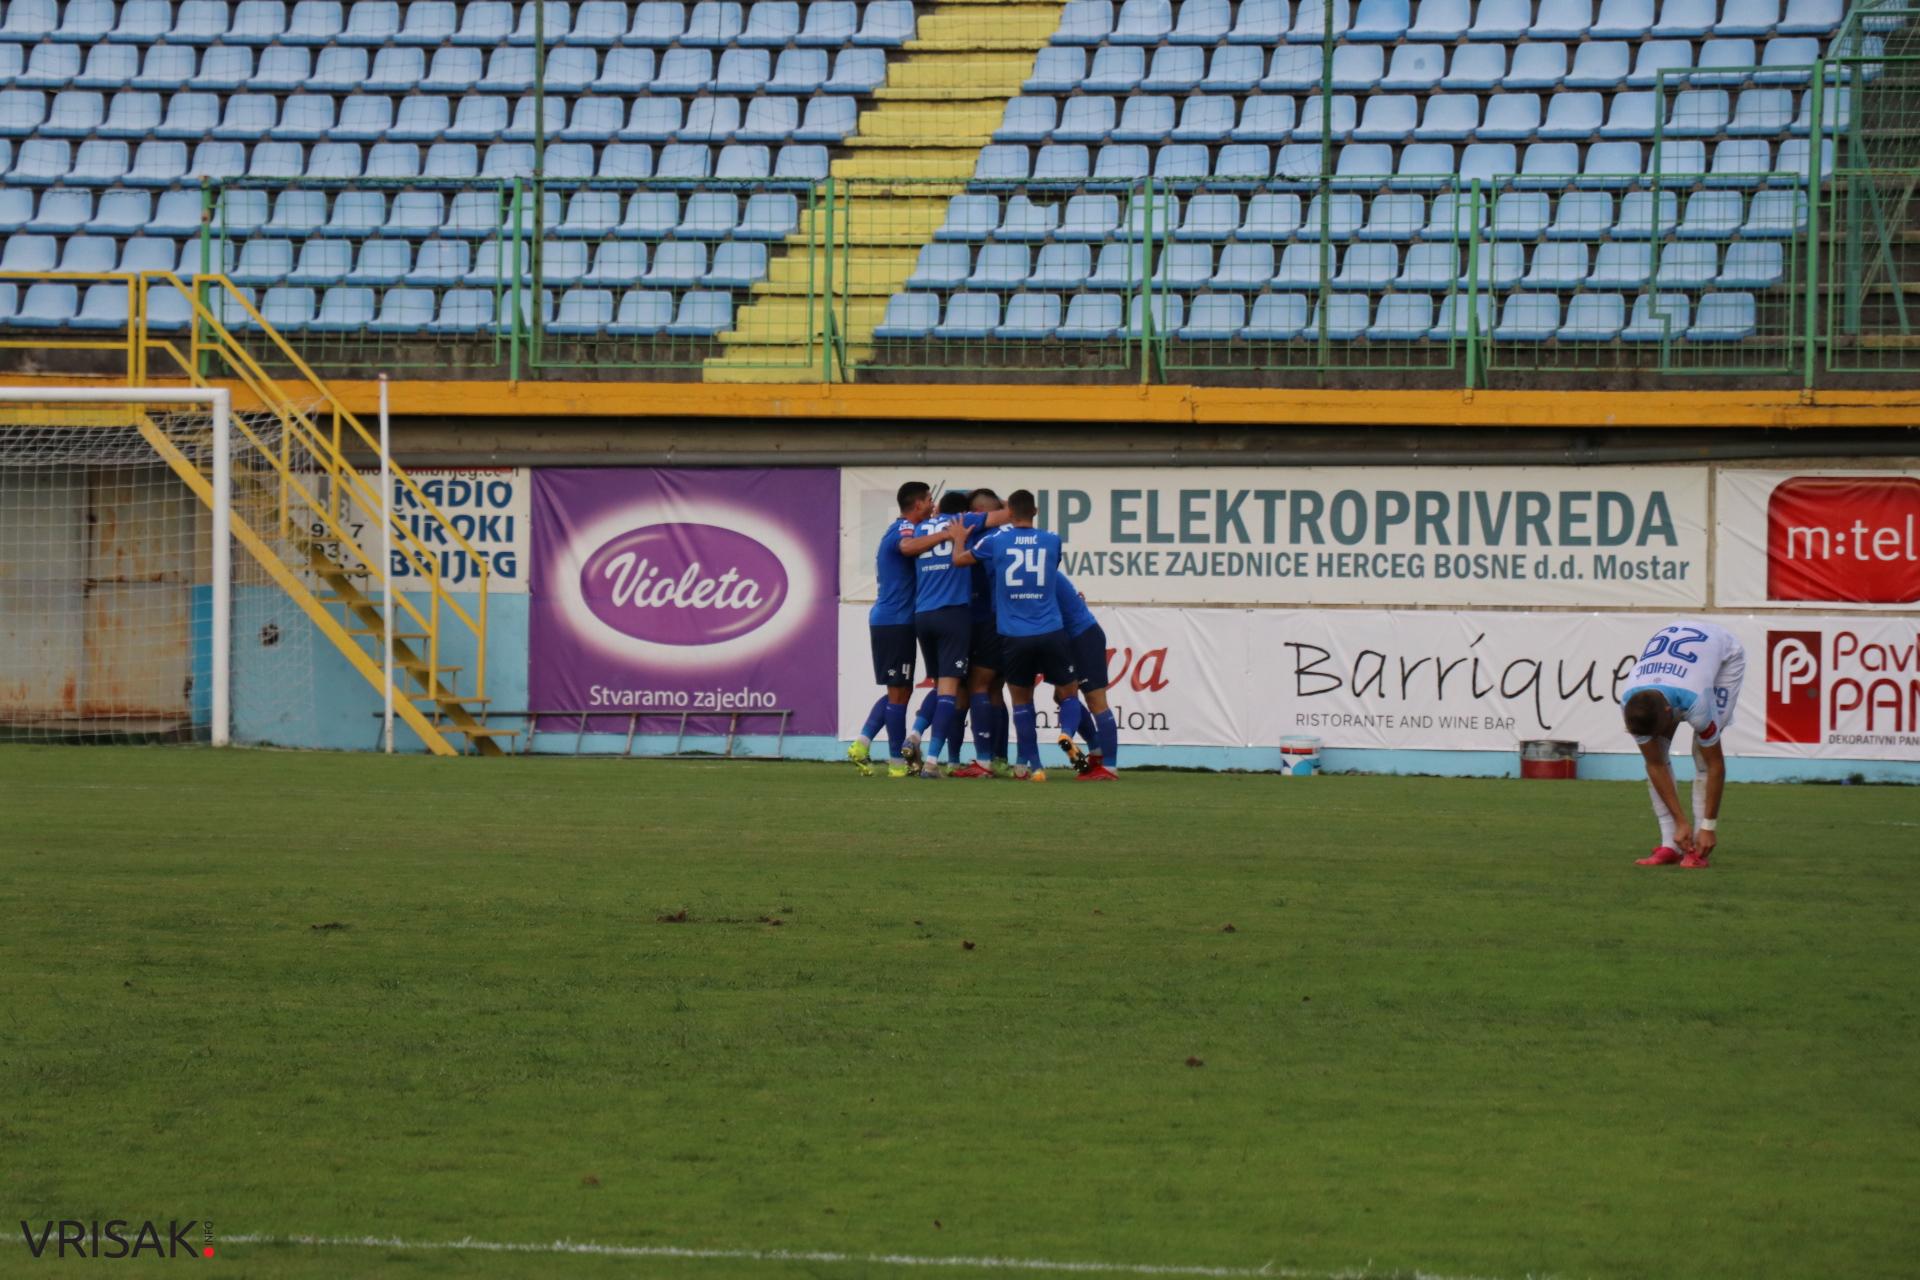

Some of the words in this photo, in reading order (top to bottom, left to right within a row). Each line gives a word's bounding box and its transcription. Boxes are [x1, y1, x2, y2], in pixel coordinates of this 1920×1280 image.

[394, 479, 513, 509] RADIO
[1110, 489, 1679, 547] ELEKTROPRIVREDA
[1014, 534, 1038, 545] JURIĆ
[1787, 514, 1917, 561] m:tel
[605, 552, 762, 609] Violeta
[1005, 548, 1047, 587] 24
[1062, 551, 1159, 577] VATSKE
[1165, 552, 1308, 578] ZAJEDNICE
[1316, 552, 1425, 579] HERCEG
[1434, 554, 1527, 580] BOSNE
[1534, 554, 1584, 580] d.d.
[1592, 554, 1690, 581] Mostar
[902, 663, 911, 680] 4
[590, 685, 688, 707] Stvaramo
[693, 687, 776, 711] zajedno
[1296, 713, 1394, 729] RISTORANTE
[1399, 715, 1434, 730] AND
[1438, 715, 1480, 730] WINE
[1484, 716, 1516, 731] BAR
[1828, 734, 1896, 745] DEKORATIVNI
